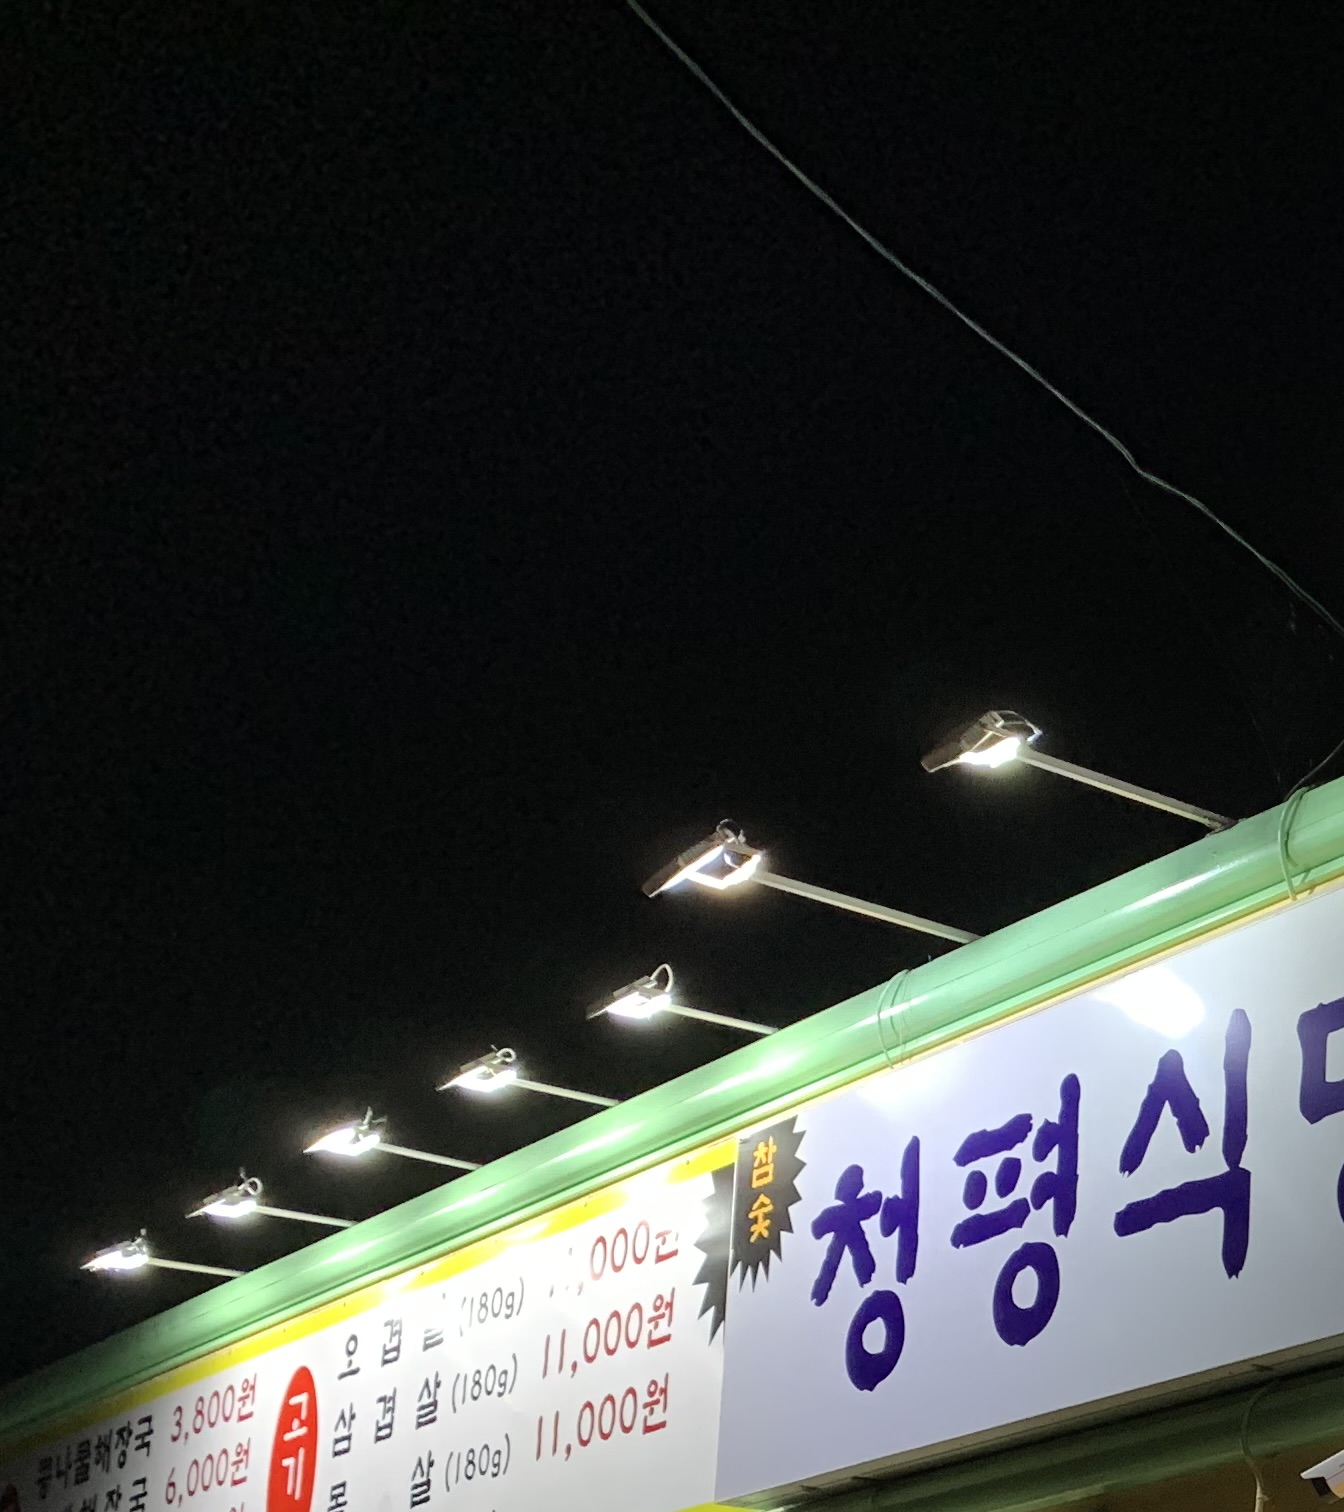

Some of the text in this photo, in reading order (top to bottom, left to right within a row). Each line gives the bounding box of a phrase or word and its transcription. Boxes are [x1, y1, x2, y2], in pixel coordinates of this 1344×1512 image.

[747, 1136, 778, 1244] 참숯
[170, 1372, 257, 1445] 3,800원
[332, 1286, 675, 1458] 삼겹살 (180g) 11,000원
[165, 1437, 250, 1507] 6,000원
[444, 1433, 510, 1492] (180g)
[535, 1372, 669, 1462] 11,000원
